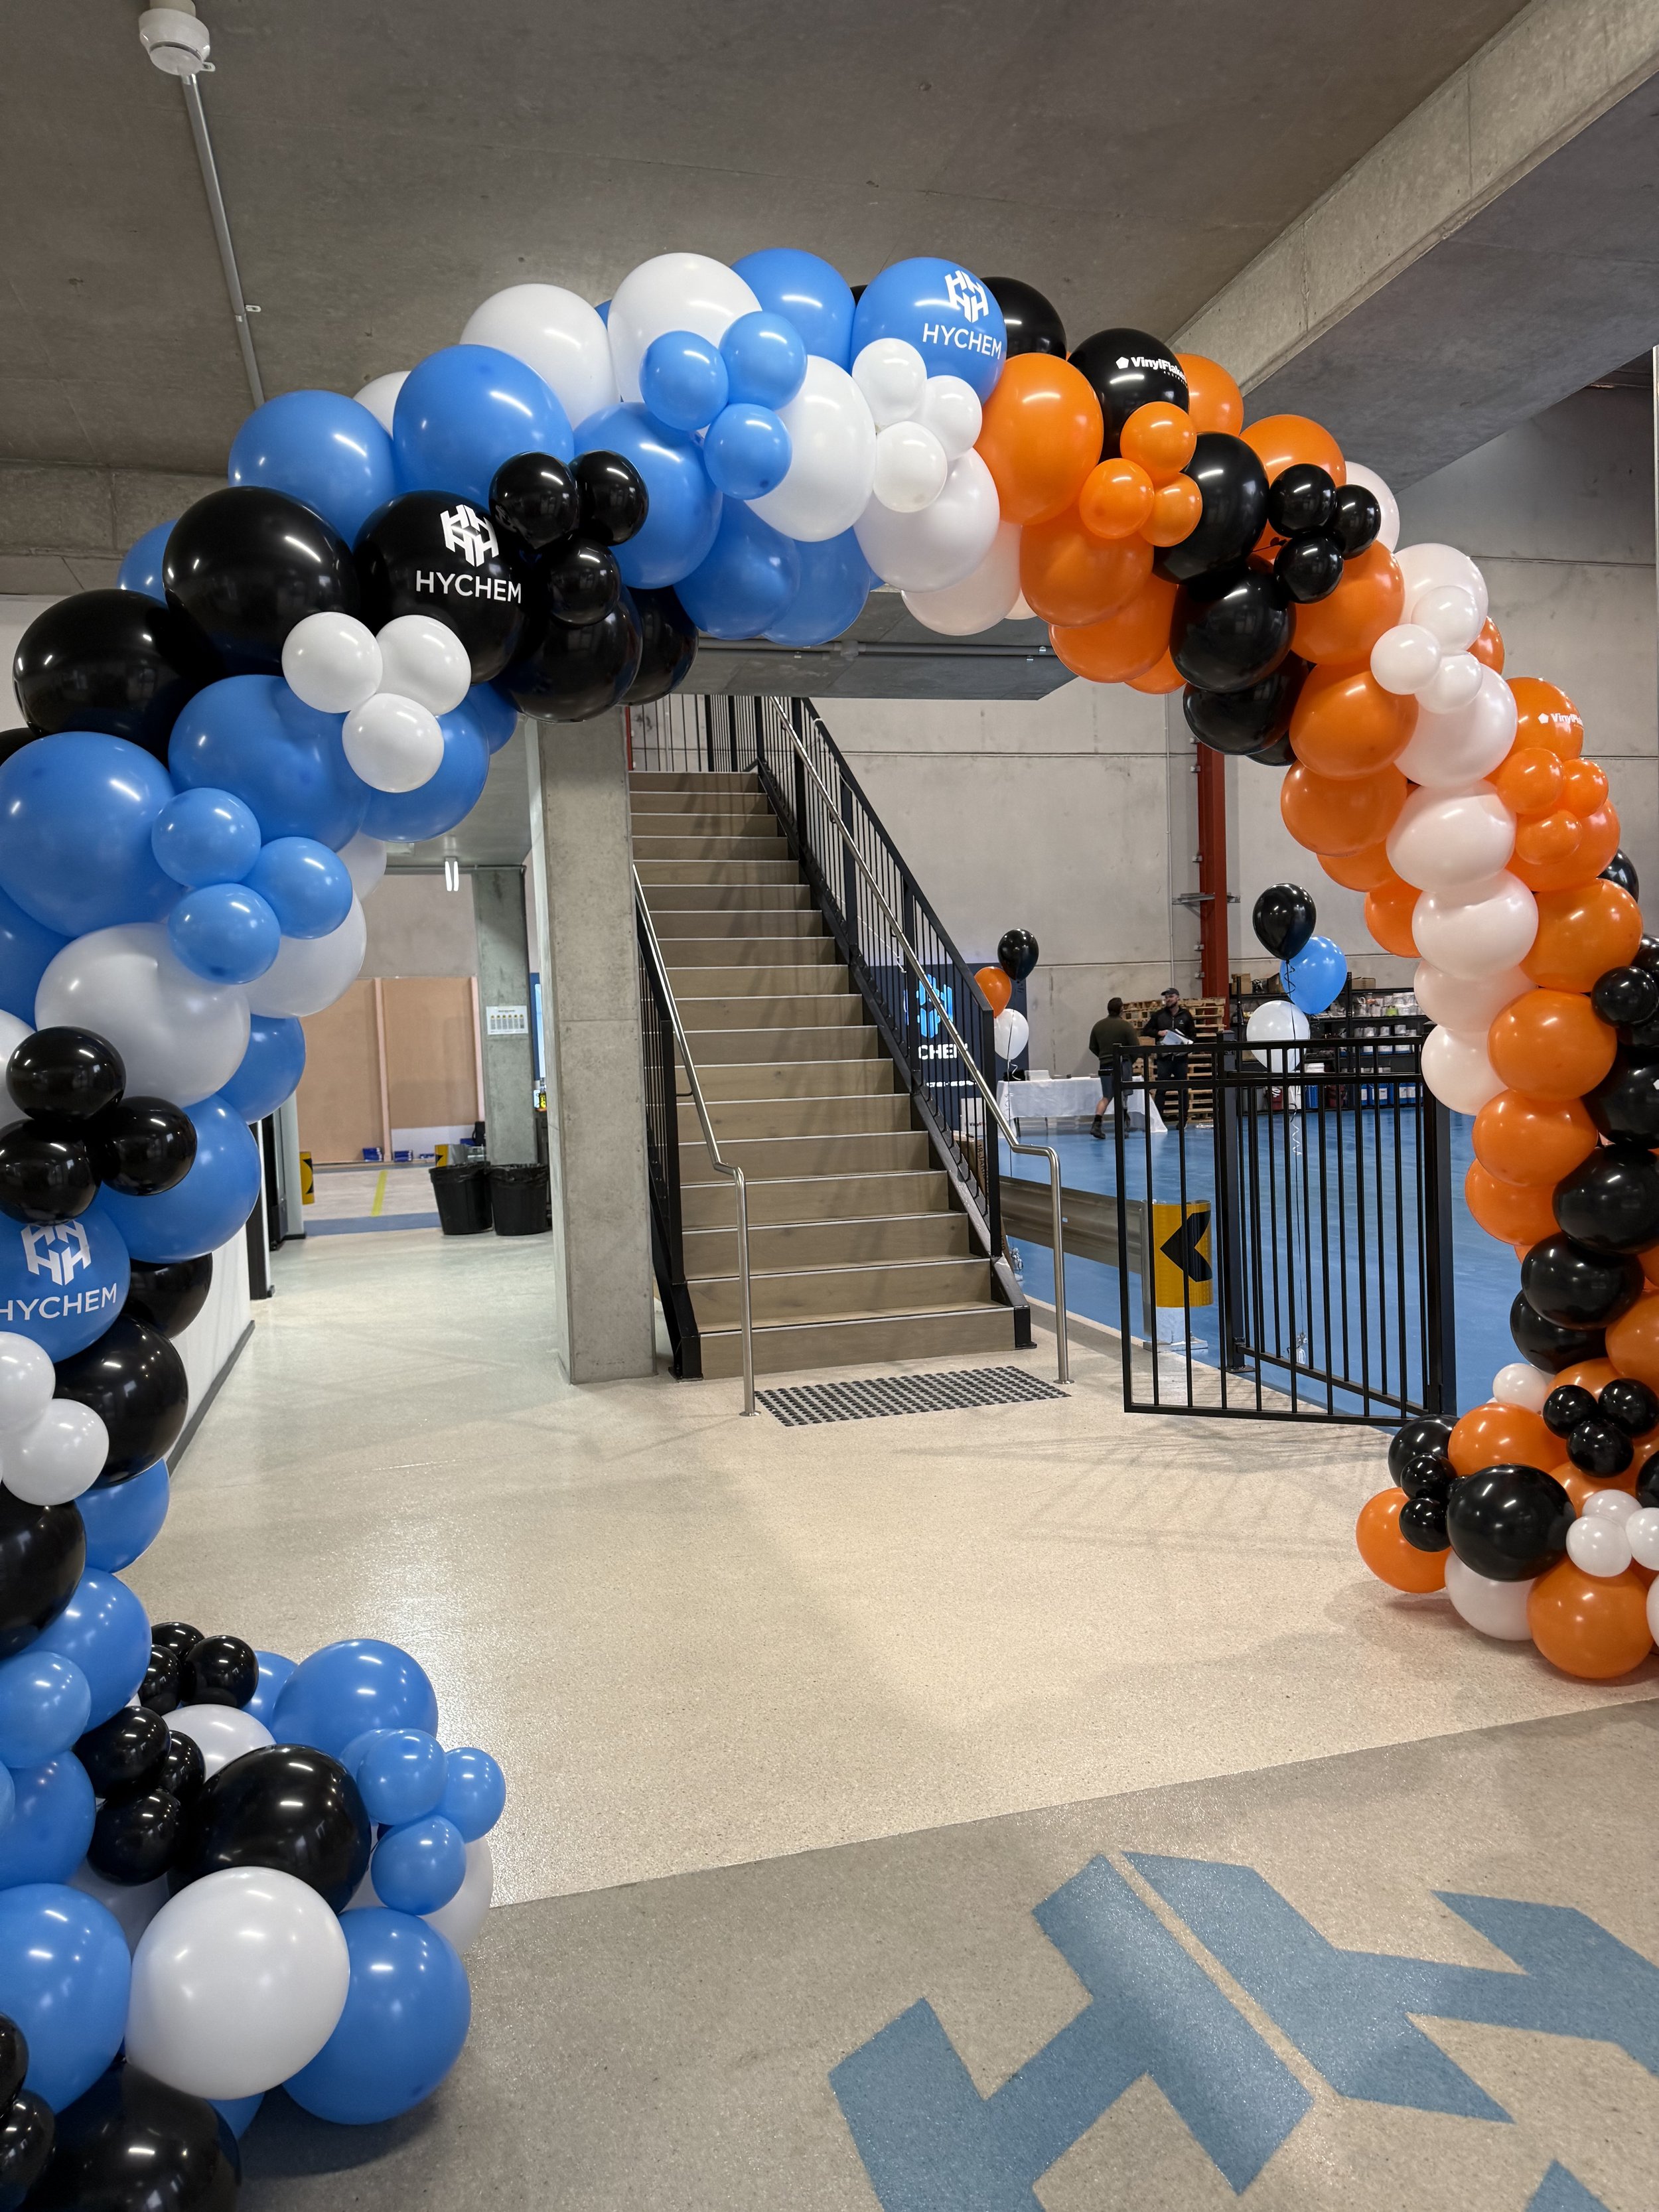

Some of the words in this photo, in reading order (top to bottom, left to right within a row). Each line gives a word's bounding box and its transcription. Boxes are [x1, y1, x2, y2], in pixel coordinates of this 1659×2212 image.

[922, 323, 1002, 360] HYCHEM
[416, 570, 522, 604] HYCHEM
[0, 1283, 117, 1321] HYCHEM
